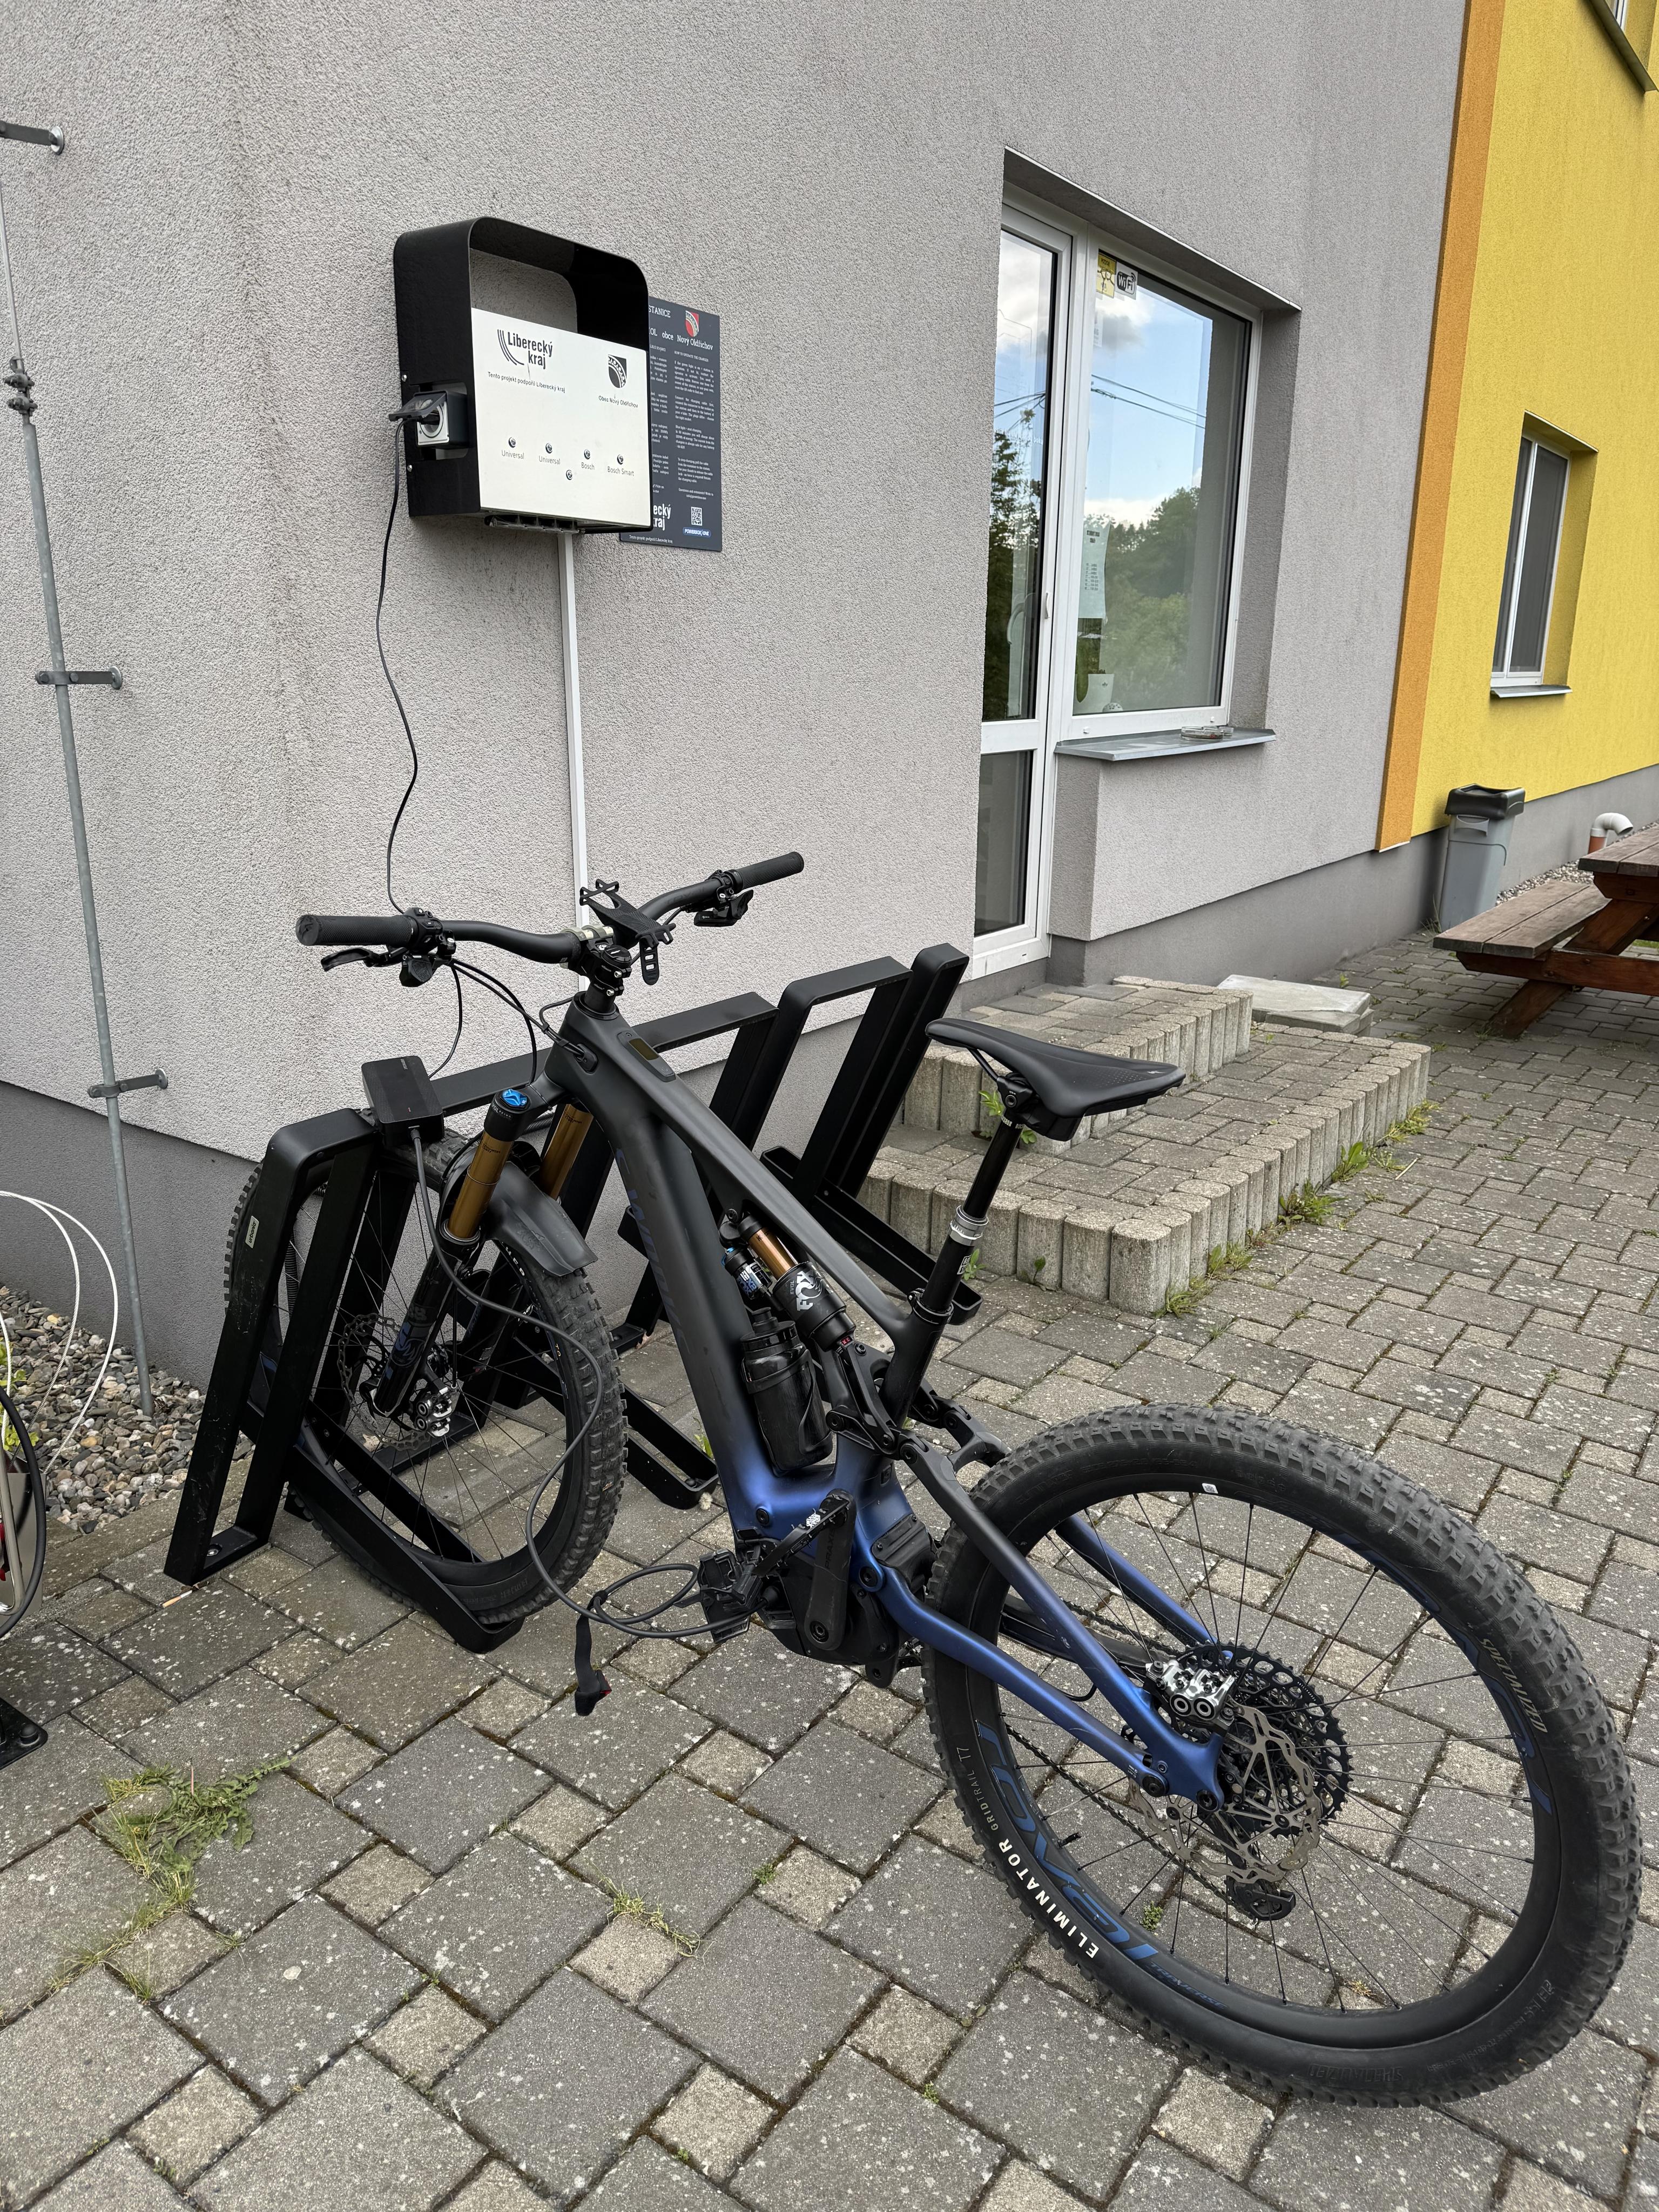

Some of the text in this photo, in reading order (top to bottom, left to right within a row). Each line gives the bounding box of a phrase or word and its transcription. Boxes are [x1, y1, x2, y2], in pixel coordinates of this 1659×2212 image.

[508, 332, 552, 358] Liberecký
[662, 331, 674, 340] obce
[677, 335, 689, 346] Nový
[528, 350, 546, 369] kraj
[536, 382, 557, 392] Liberecký
[501, 450, 524, 460] Universal
[538, 456, 561, 466] Universal
[581, 462, 595, 470] Bosch
[608, 466, 634, 476] Bosch Smart
[653, 516, 665, 531] raj
[795, 1270, 824, 1311] FOX
[1480, 1638, 1548, 1733] SPECIALIZED
[956, 1747, 971, 1763] T7
[999, 1838, 1100, 1959] ELIMINATOR
